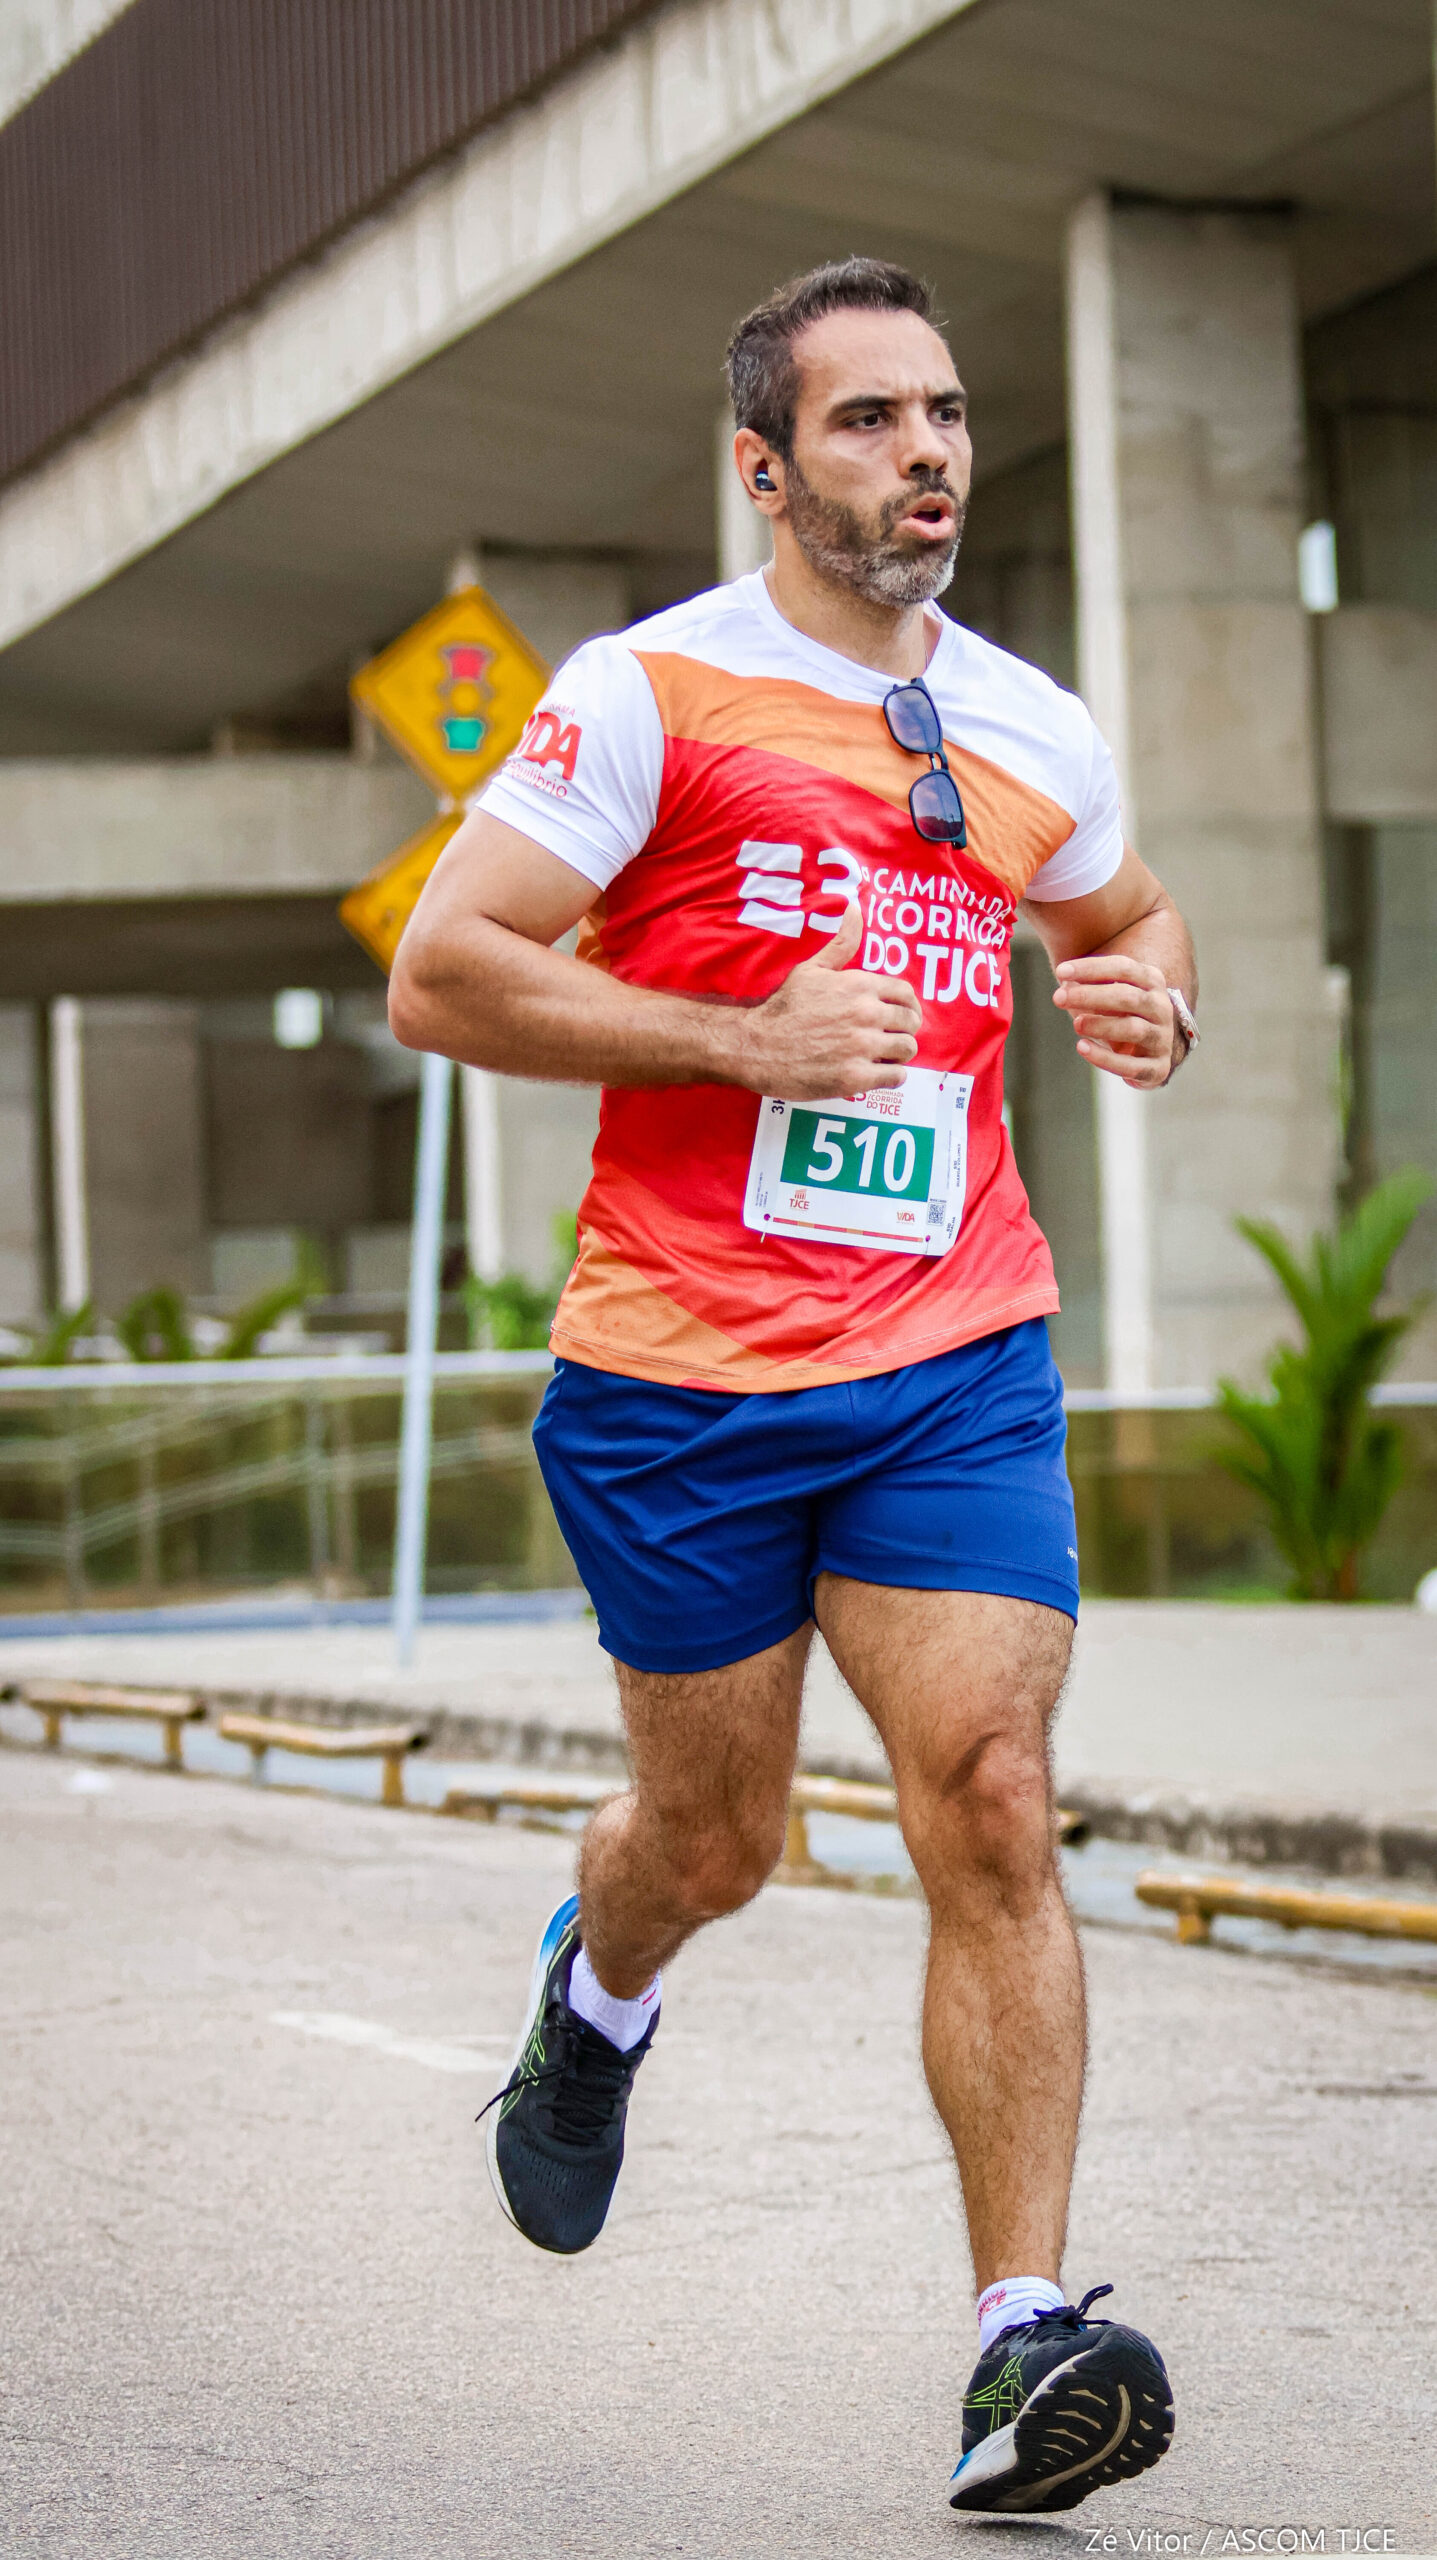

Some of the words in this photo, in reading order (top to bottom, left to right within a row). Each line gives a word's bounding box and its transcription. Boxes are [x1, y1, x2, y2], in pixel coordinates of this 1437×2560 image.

[873, 867, 1013, 921] CAMINDA
[862, 932, 909, 975] DO
[916, 943, 1002, 1008] TJCE
[866, 1101, 879, 1109] DO
[879, 1103, 901, 1116] TJCE
[806, 1118, 916, 1192] 510
[789, 1197, 810, 1210] TJCE
